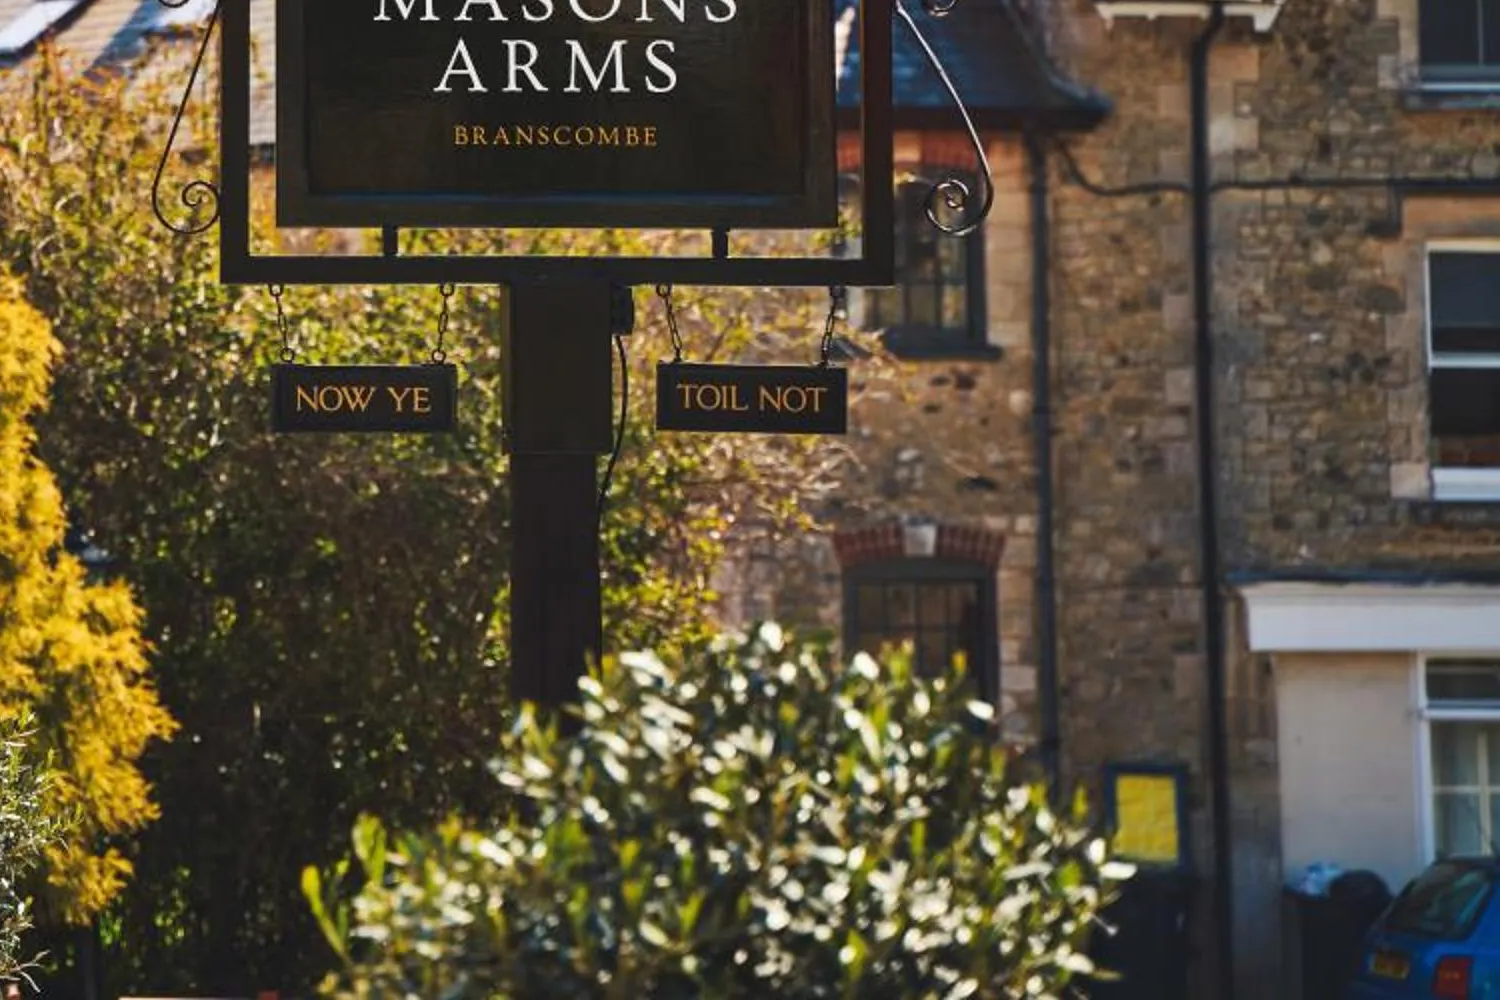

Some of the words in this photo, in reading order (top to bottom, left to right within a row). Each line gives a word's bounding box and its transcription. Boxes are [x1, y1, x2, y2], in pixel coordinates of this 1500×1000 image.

[433, 38, 678, 93] ARMS
[453, 125, 658, 147] BRANSCOMBE
[296, 385, 376, 413] NOW
[387, 386, 431, 413] YE
[676, 383, 749, 412] TOIL
[758, 385, 828, 413] NOT
